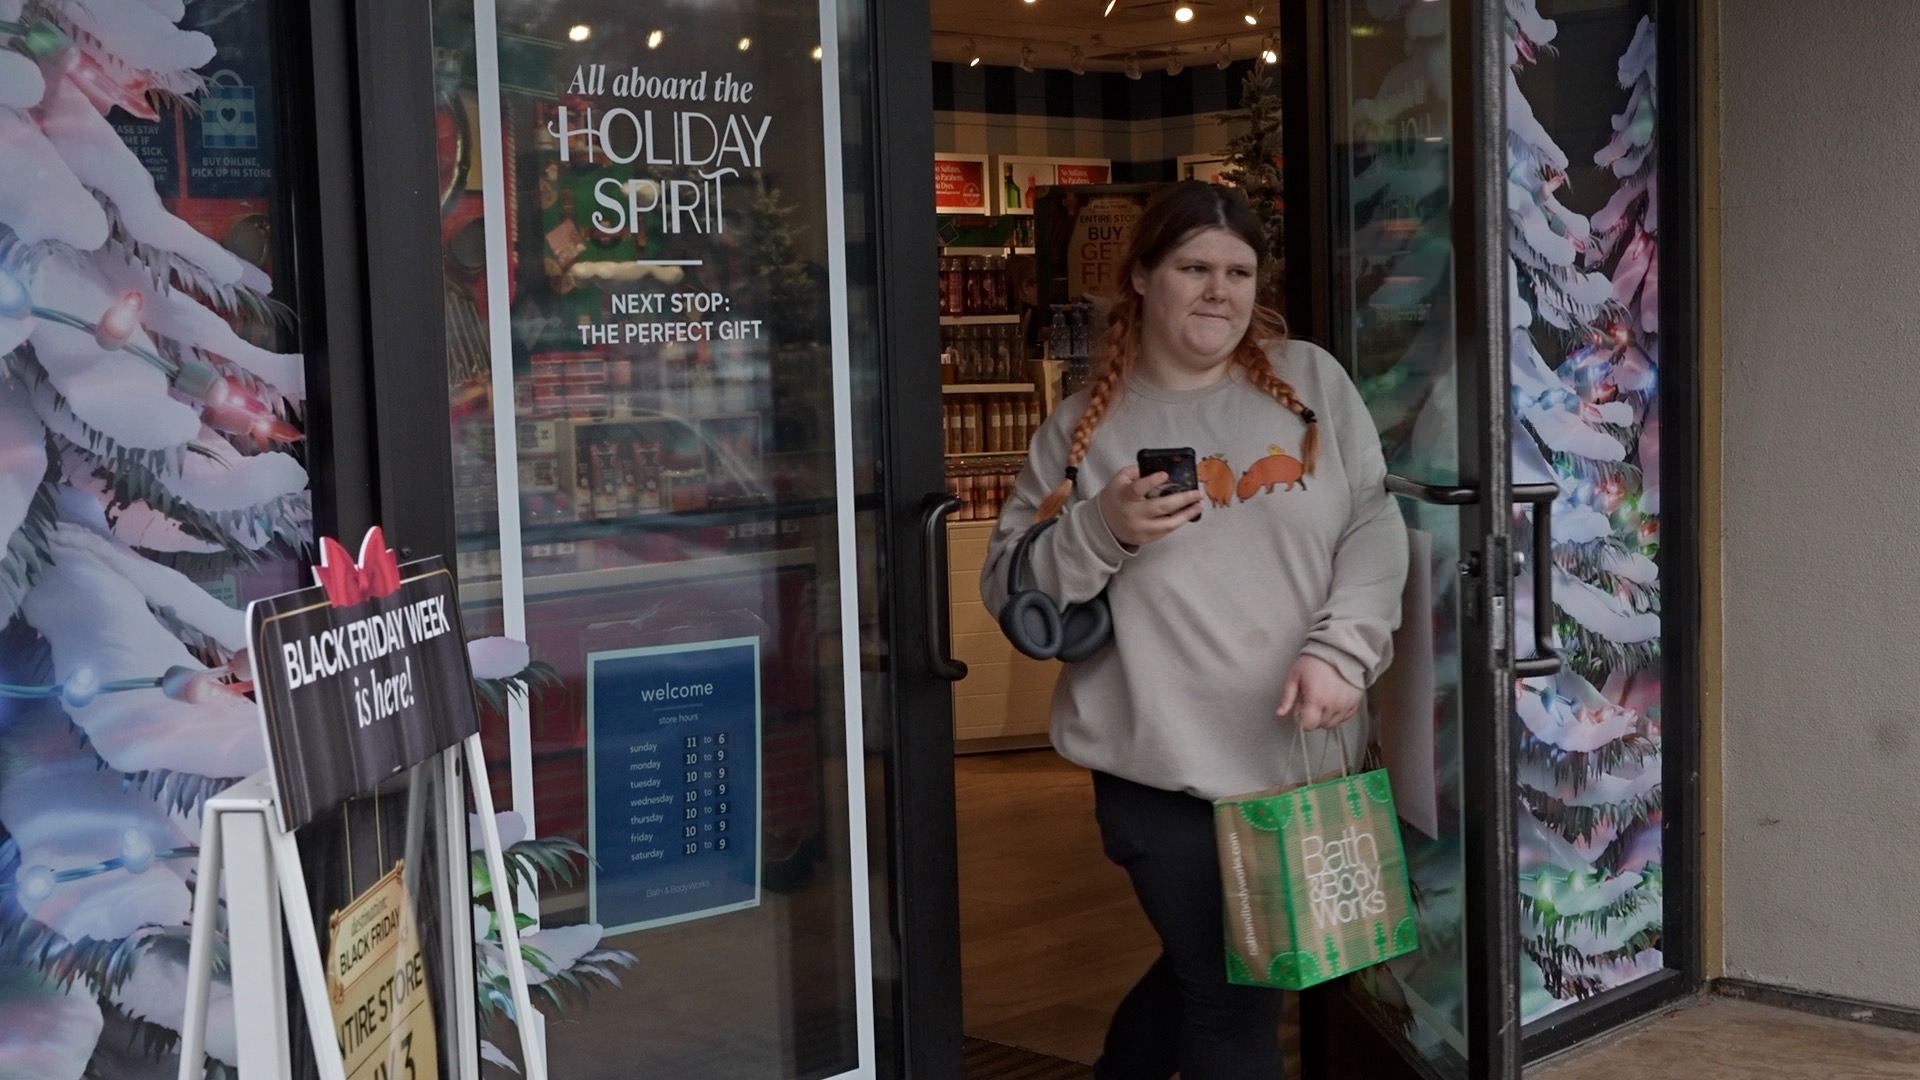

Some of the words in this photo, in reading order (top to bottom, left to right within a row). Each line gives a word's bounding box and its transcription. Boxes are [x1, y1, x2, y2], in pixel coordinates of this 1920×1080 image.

[566, 64, 605, 96] All
[612, 66, 707, 101] aboard
[714, 72, 753, 103] the
[113, 125, 135, 135] ASE
[137, 126, 159, 135] STAY
[141, 136, 150, 145] IF
[547, 105, 772, 167] HOLIDAY
[141, 147, 163, 156] SICK
[202, 157, 222, 166] BUY
[223, 157, 260, 167] ONLINE,
[192, 168, 214, 177] PICK
[215, 168, 228, 177] UP
[231, 168, 240, 177] IN
[242, 168, 272, 178] STORE
[592, 167, 740, 235] SPIRIT
[1080, 214, 1112, 223] ENTIRE
[1088, 226, 1123, 240] BUY
[611, 293, 665, 314] NEXT
[671, 292, 731, 313] STOP:
[578, 324, 619, 345] THE
[625, 321, 713, 343] PERFECT
[718, 320, 762, 341] GIFT
[283, 628, 351, 690] BLACK
[348, 608, 406, 667] FRIDAY
[403, 595, 451, 645] WEEK
[354, 676, 372, 728] is
[371, 656, 415, 721] here!
[641, 680, 714, 703] welcome
[658, 714, 678, 725] store
[678, 712, 699, 724] hours
[629, 741, 658, 754] sunday
[686, 736, 697, 749] 11
[704, 735, 712, 744] to
[718, 734, 725, 745] 6
[629, 759, 661, 773] monday
[686, 753, 698, 765] 10
[704, 753, 712, 761] to
[718, 751, 725, 762] 9
[629, 776, 661, 790] tuesday
[686, 771, 698, 783] 10
[704, 770, 712, 779] to
[718, 768, 726, 779] 9
[630, 793, 674, 808] wednesday
[686, 790, 698, 803] 10
[704, 788, 713, 797] to
[718, 784, 726, 796] 9
[630, 811, 664, 825] thursday
[686, 807, 698, 819] 10
[704, 805, 713, 814] to
[719, 803, 727, 814] 9
[630, 831, 654, 844] friday
[686, 826, 698, 838] 10
[704, 823, 713, 831] to
[719, 821, 727, 832] 9
[630, 848, 665, 861] saturday
[686, 842, 698, 855] 10
[704, 840, 713, 849] to
[719, 839, 727, 850] 9
[1301, 826, 1379, 879] Bath
[1310, 891, 1388, 929] Works
[340, 932, 371, 976] BLACK
[371, 905, 401, 949] FRIDAY
[337, 996, 378, 1060] NTIRE
[378, 952, 423, 1023] STORE
